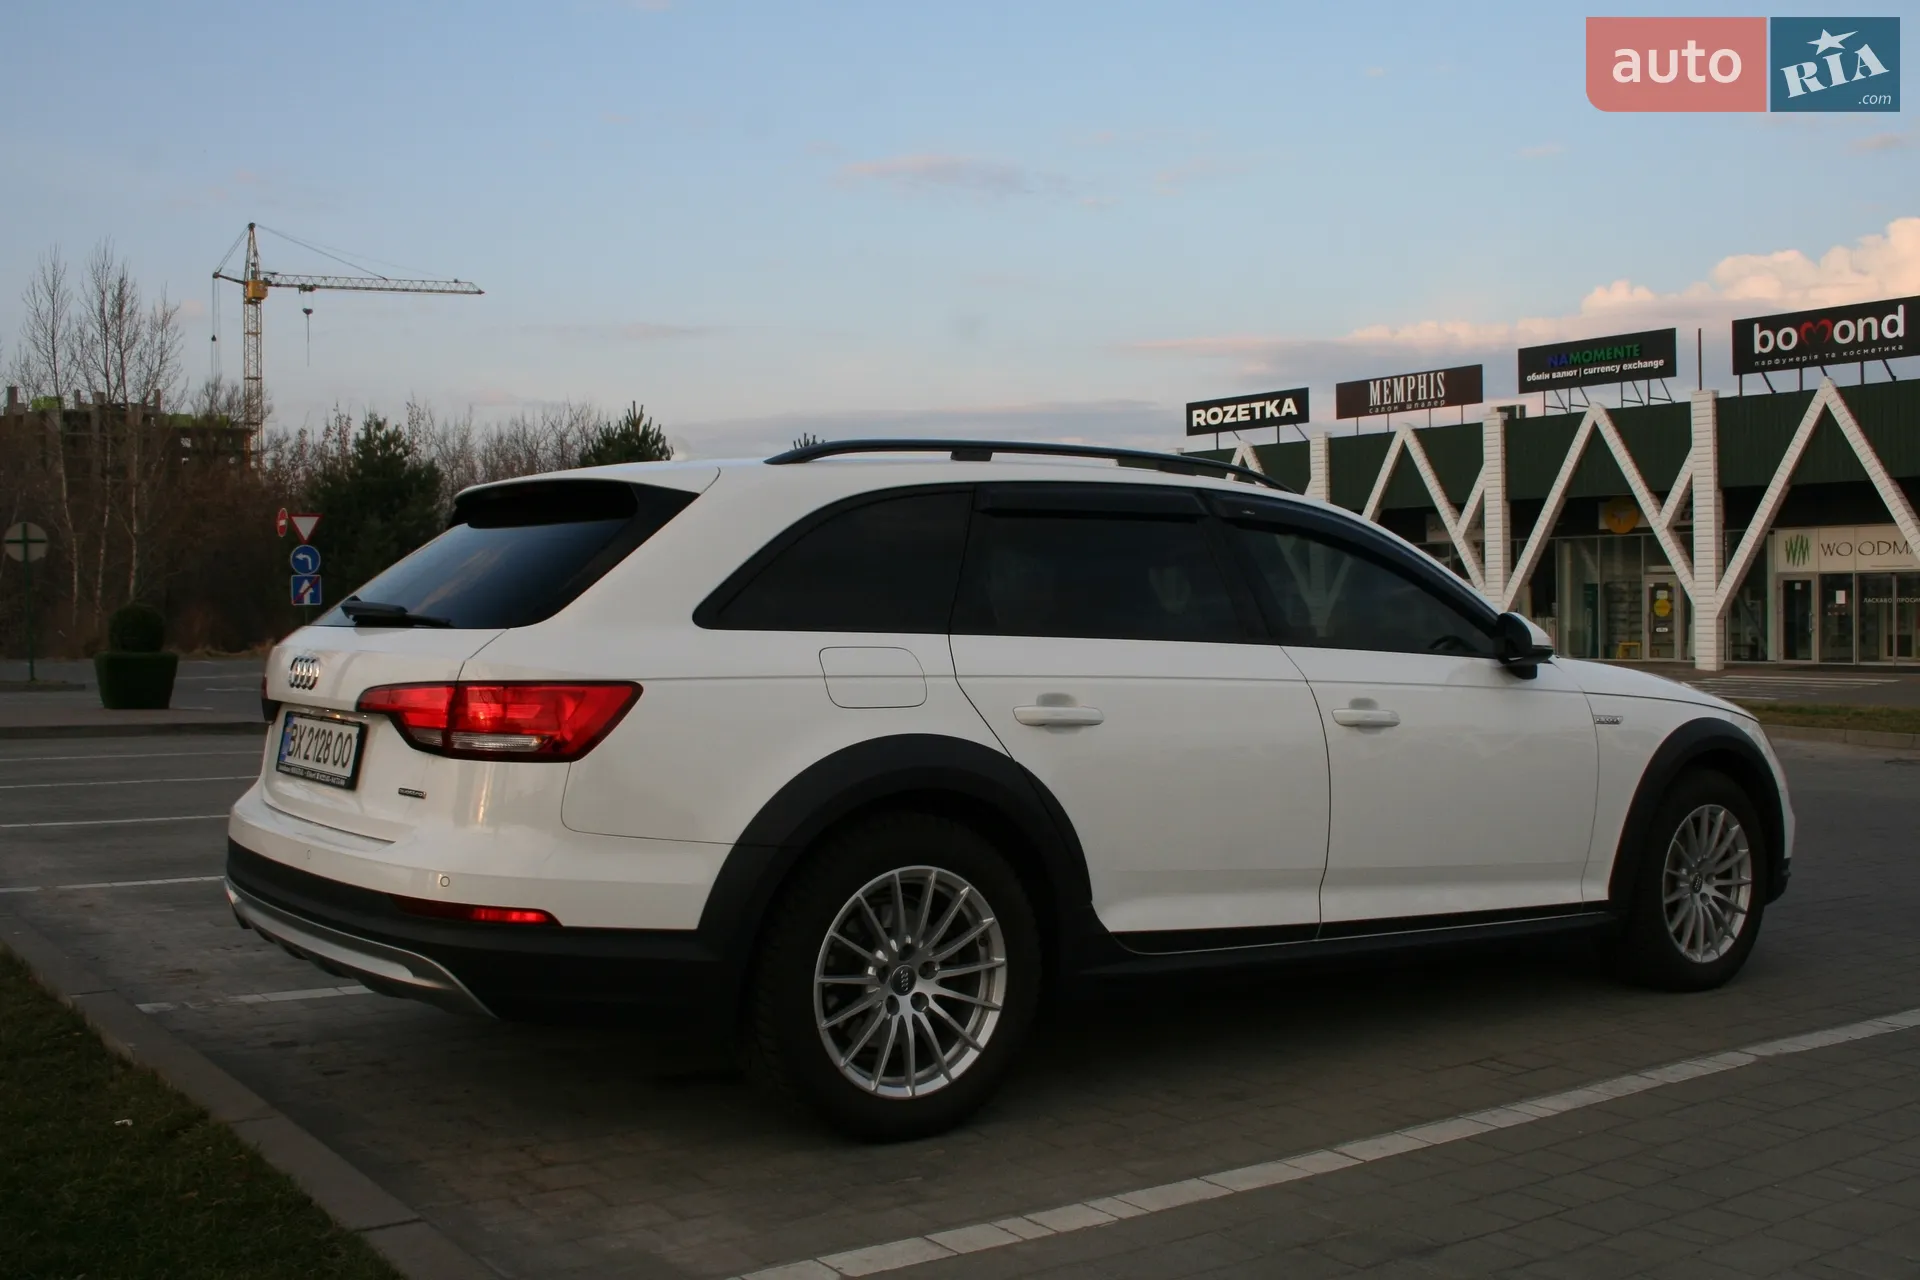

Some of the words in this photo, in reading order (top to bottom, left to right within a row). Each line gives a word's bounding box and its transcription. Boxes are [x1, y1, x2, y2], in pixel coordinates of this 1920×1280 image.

[1547, 343, 1641, 367] NAMOMENTE
[1754, 353, 1819, 367] парфумерія
[1842, 344, 1904, 357] косметика
[1526, 371, 1550, 382] обмін
[1552, 369, 1577, 379] валют
[1583, 364, 1621, 375] currency
[1622, 358, 1665, 371] exchange
[1368, 371, 1446, 407] MEMPHIS
[1191, 397, 1298, 428] ROZETKA
[1368, 405, 1399, 414] салон
[1406, 399, 1446, 410] шпалер
[303, 727, 333, 764] 2128
